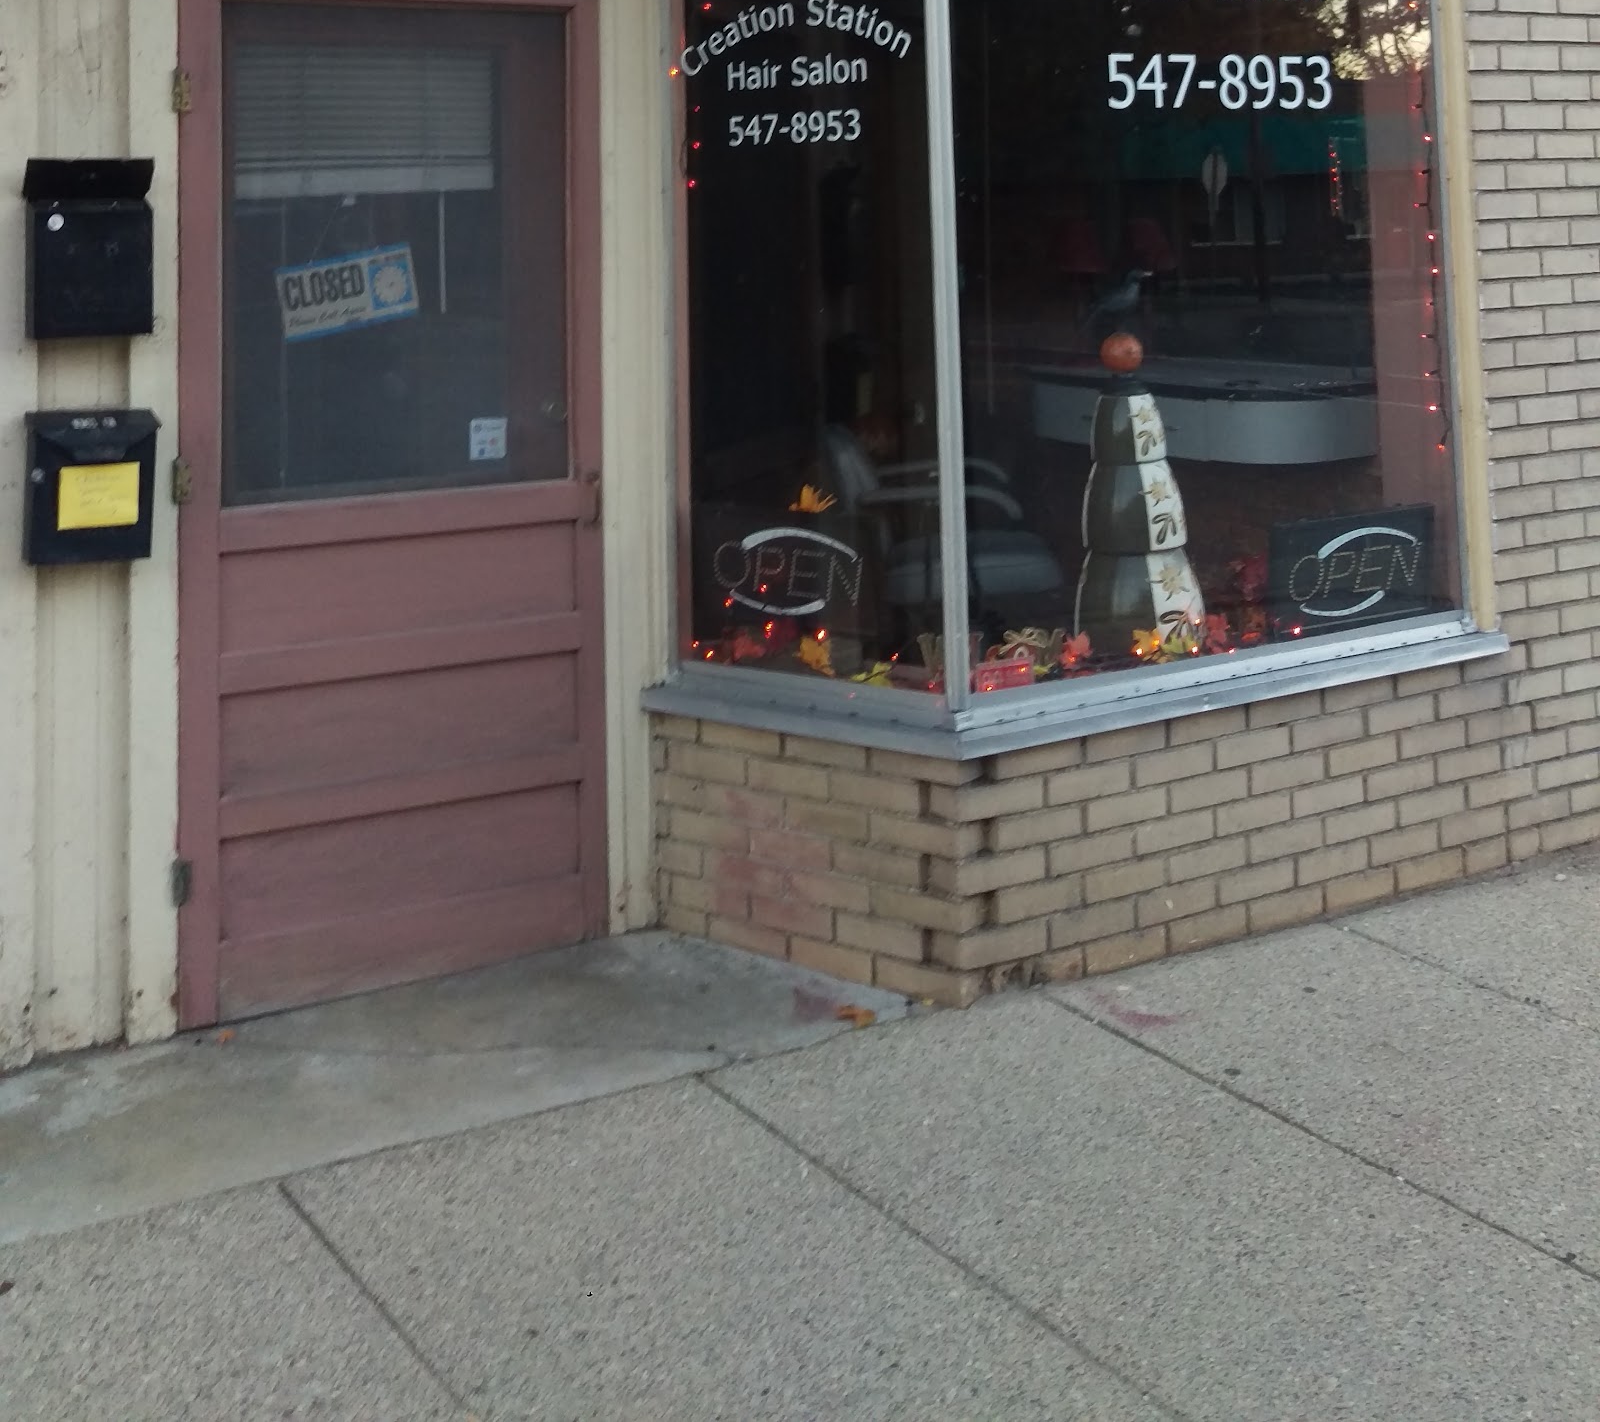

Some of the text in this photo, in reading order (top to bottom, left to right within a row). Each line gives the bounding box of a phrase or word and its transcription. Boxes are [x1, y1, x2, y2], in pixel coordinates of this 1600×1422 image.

[680, 2, 795, 77] Creation
[726, 52, 868, 91] Hair Salon
[1107, 53, 1334, 110] 547-8953
[728, 108, 862, 147] 547-8953
[283, 264, 366, 311] CLOSED
[713, 540, 863, 606] OPEN
[1289, 541, 1423, 601] OPEN
